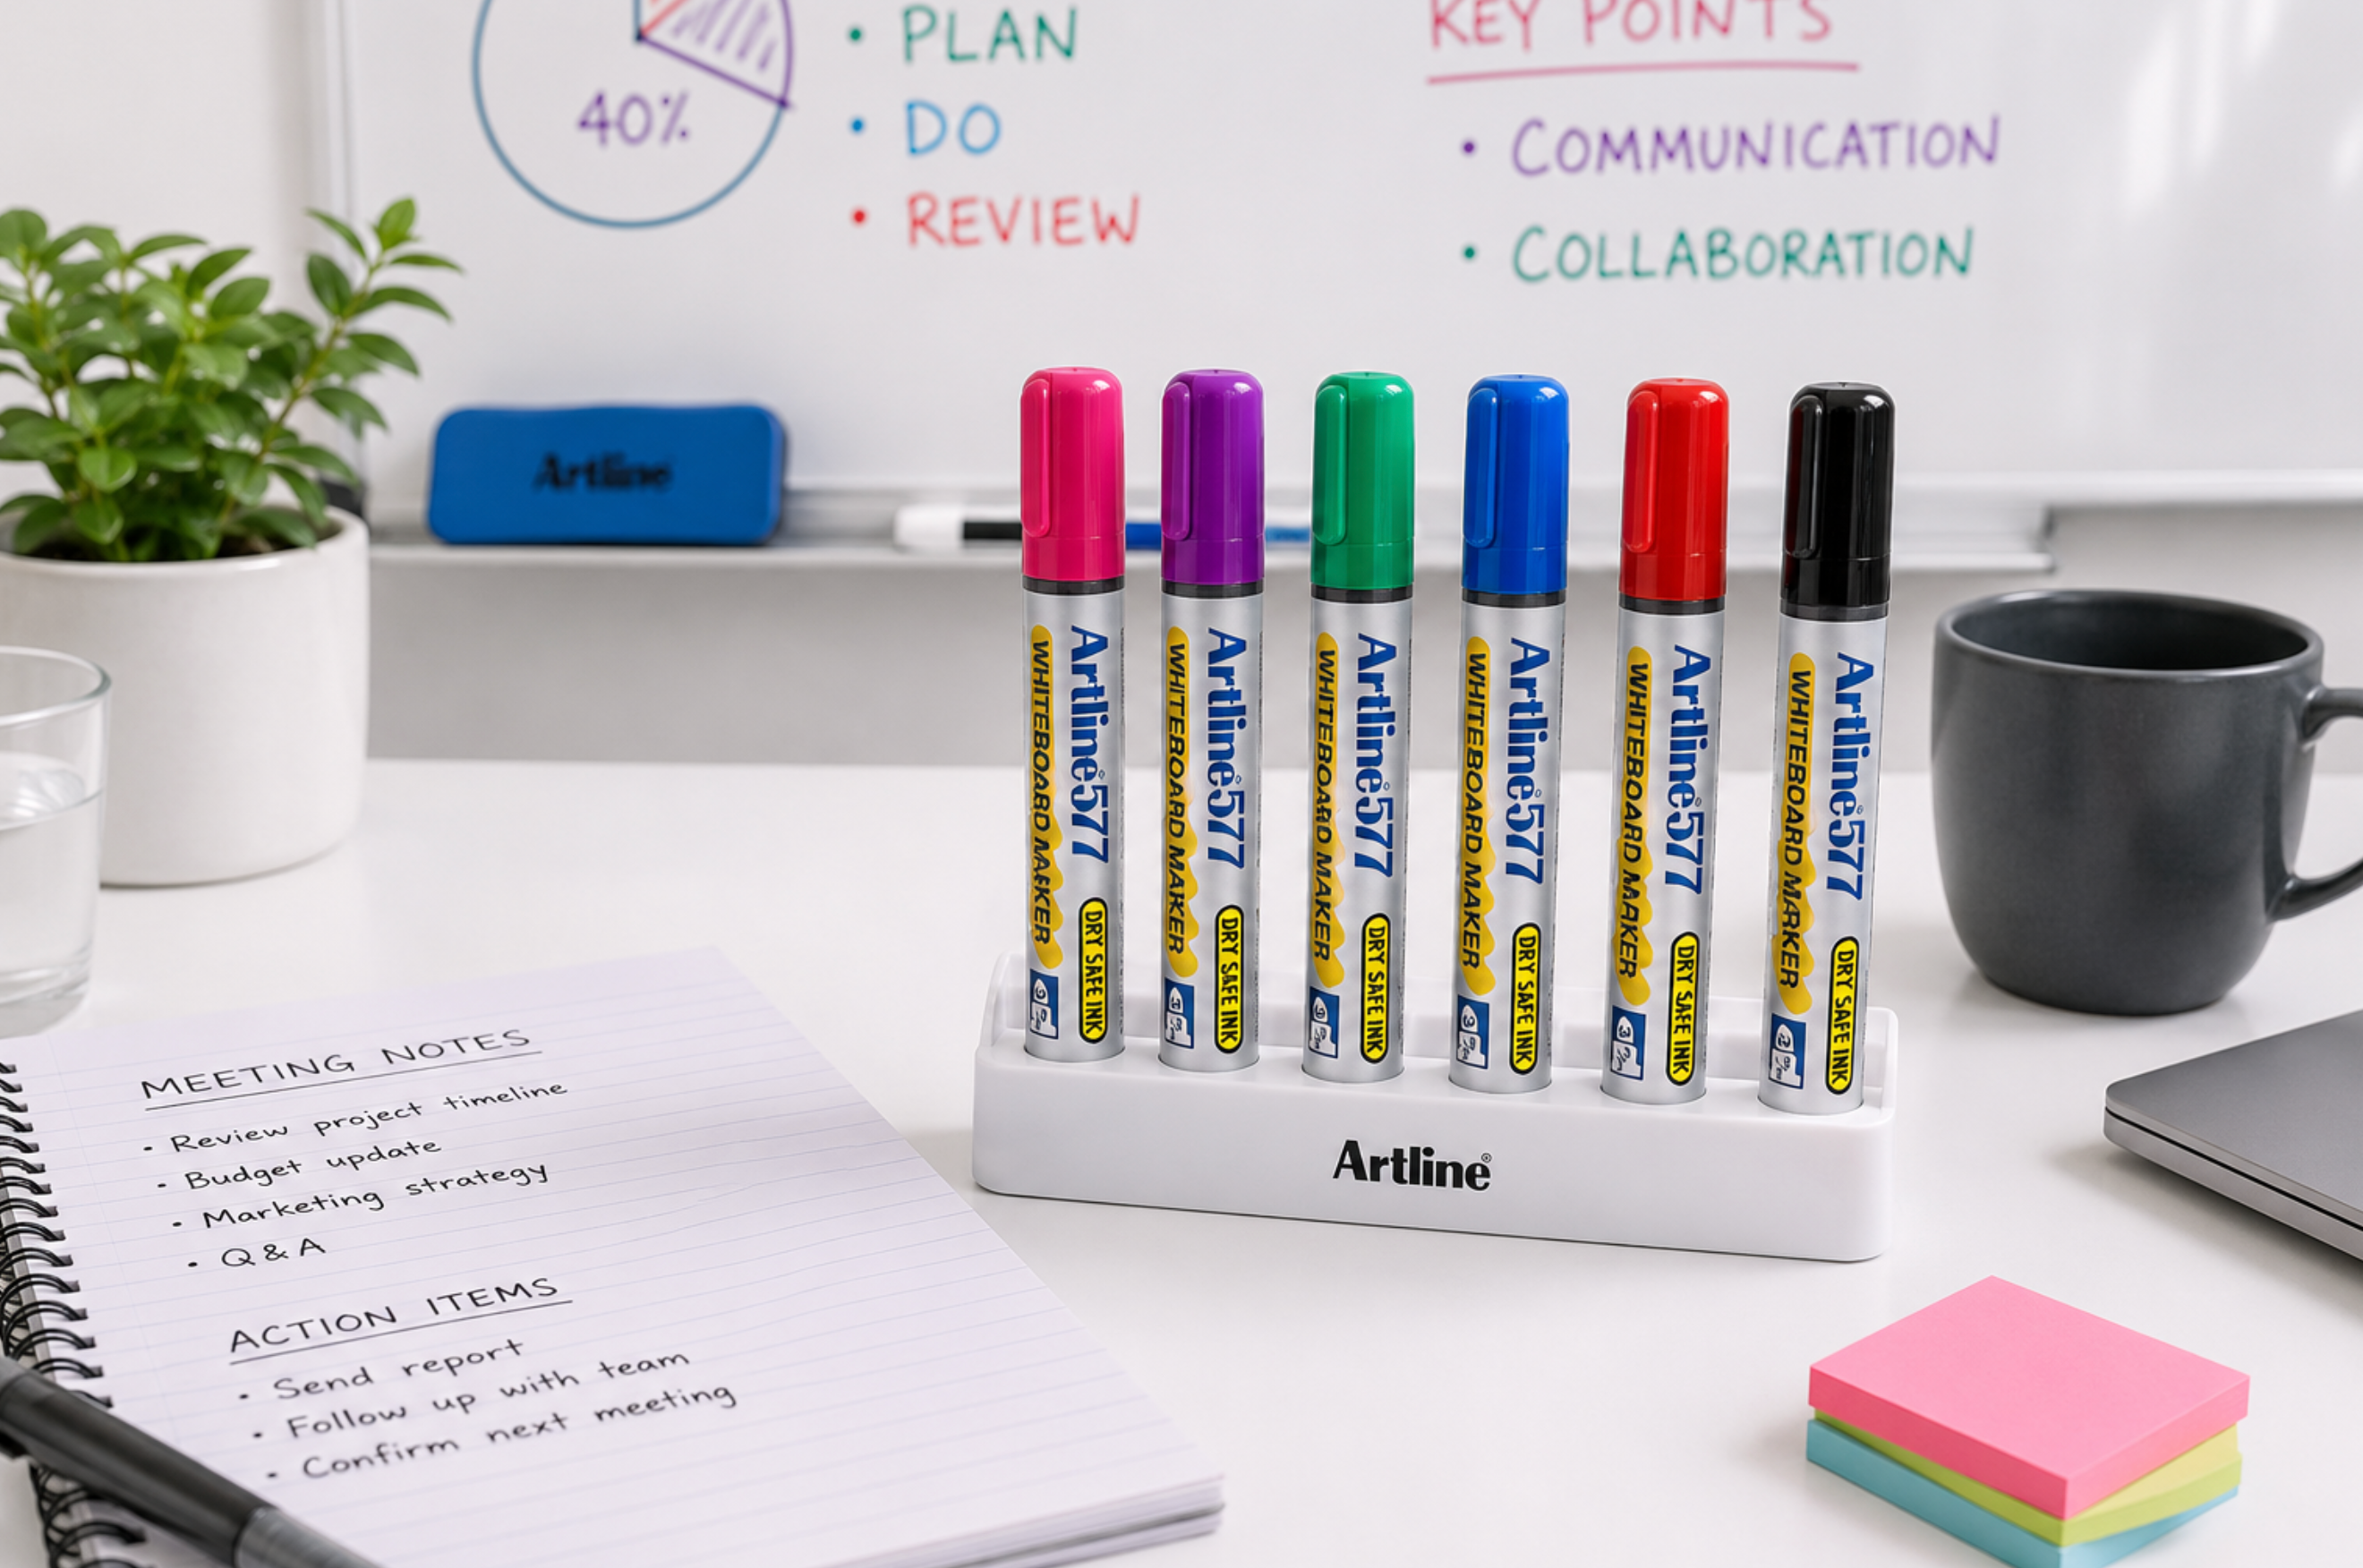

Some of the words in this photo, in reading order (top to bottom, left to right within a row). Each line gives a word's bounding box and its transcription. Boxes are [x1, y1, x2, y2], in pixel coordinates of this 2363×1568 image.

[903, 5, 1076, 62] PLAN
[1430, 0, 1540, 51] KEY
[1582, 0, 1831, 44] POINTS
[578, 90, 688, 147] 40%
[905, 99, 1002, 157] DO
[1513, 118, 1998, 176] COMMUNICATION
[907, 192, 1140, 248] REVIEW
[1514, 226, 1972, 281] COLLABORATION
[534, 453, 672, 490] Artline
[1165, 643, 1186, 839] WHITEBOARD
[1315, 650, 1335, 845] WHITEBOARD
[1464, 653, 1487, 855] WHITEBOARD
[1623, 663, 1649, 864] WHITEBOARD
[1784, 670, 1812, 866] WHITEBOARD
[1085, 910, 1104, 947] DRY
[1221, 917, 1239, 956] DRY
[1460, 862, 1482, 970] MAKER
[1368, 926, 1386, 965] DRY
[1518, 935, 1537, 974] DRY
[1676, 945, 1695, 984] DRY
[1836, 950, 1855, 989] DRY
[1085, 953, 1104, 998] SAFE
[1221, 961, 1239, 1006] SAFE
[1367, 970, 1385, 1015] SAFE
[1085, 1001, 1103, 1035] INK
[1220, 1010, 1239, 1044] INK
[1516, 980, 1534, 1025] SAFE
[1673, 990, 1693, 1034] SAFE
[1833, 995, 1852, 1044] SAFE
[1366, 1019, 1384, 1053] INK
[1515, 1029, 1533, 1064] INK
[1673, 1040, 1691, 1075] INK
[141, 1053, 355, 1100] MEETING
[381, 1029, 530, 1064] NOTES
[1831, 1048, 1849, 1084] INK
[170, 1126, 287, 1153] Review
[313, 1102, 422, 1137] project
[443, 1085, 567, 1110] timeline
[184, 1160, 302, 1189] Budget
[326, 1141, 441, 1171] update
[202, 1192, 384, 1229] Marketing
[405, 1164, 548, 1196] strategy
[221, 1248, 256, 1267] Q
[263, 1244, 289, 1262] &
[300, 1238, 326, 1257] A
[230, 1306, 397, 1353] ACTION
[426, 1278, 558, 1316] ITEMS
[273, 1367, 374, 1399] Send
[401, 1339, 523, 1376] report
[286, 1406, 407, 1439] Follow
[432, 1393, 476, 1414] up
[499, 1370, 579, 1398] with
[598, 1354, 690, 1378] team
[303, 1440, 459, 1479] Confirm
[486, 1412, 567, 1443] next
[594, 1387, 737, 1422] meeting
